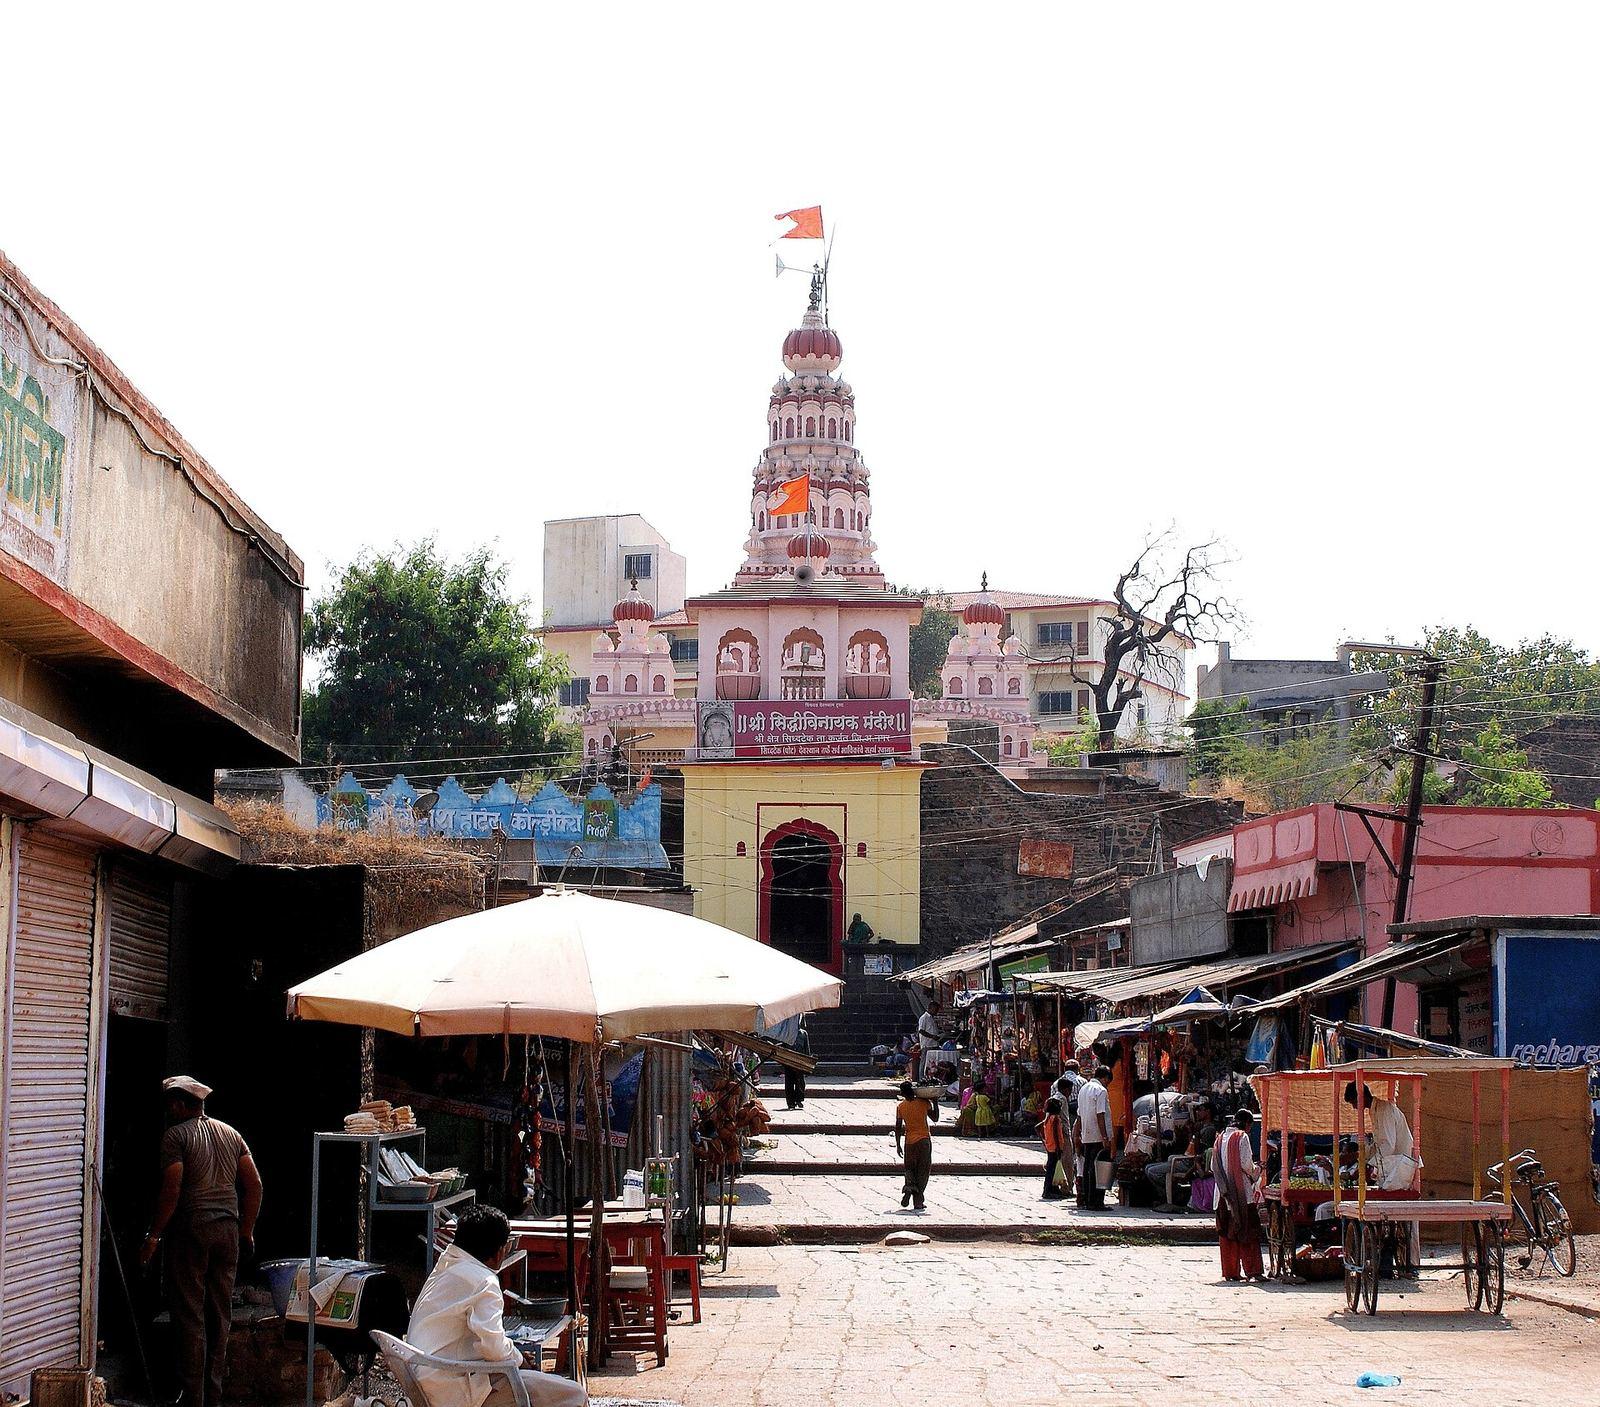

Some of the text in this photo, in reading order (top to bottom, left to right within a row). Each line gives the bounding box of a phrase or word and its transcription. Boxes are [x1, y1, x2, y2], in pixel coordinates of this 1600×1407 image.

[754, 734, 764, 743] श्री
[767, 734, 779, 743] क्षेत्र
[1511, 1038, 1600, 1065] recharg
